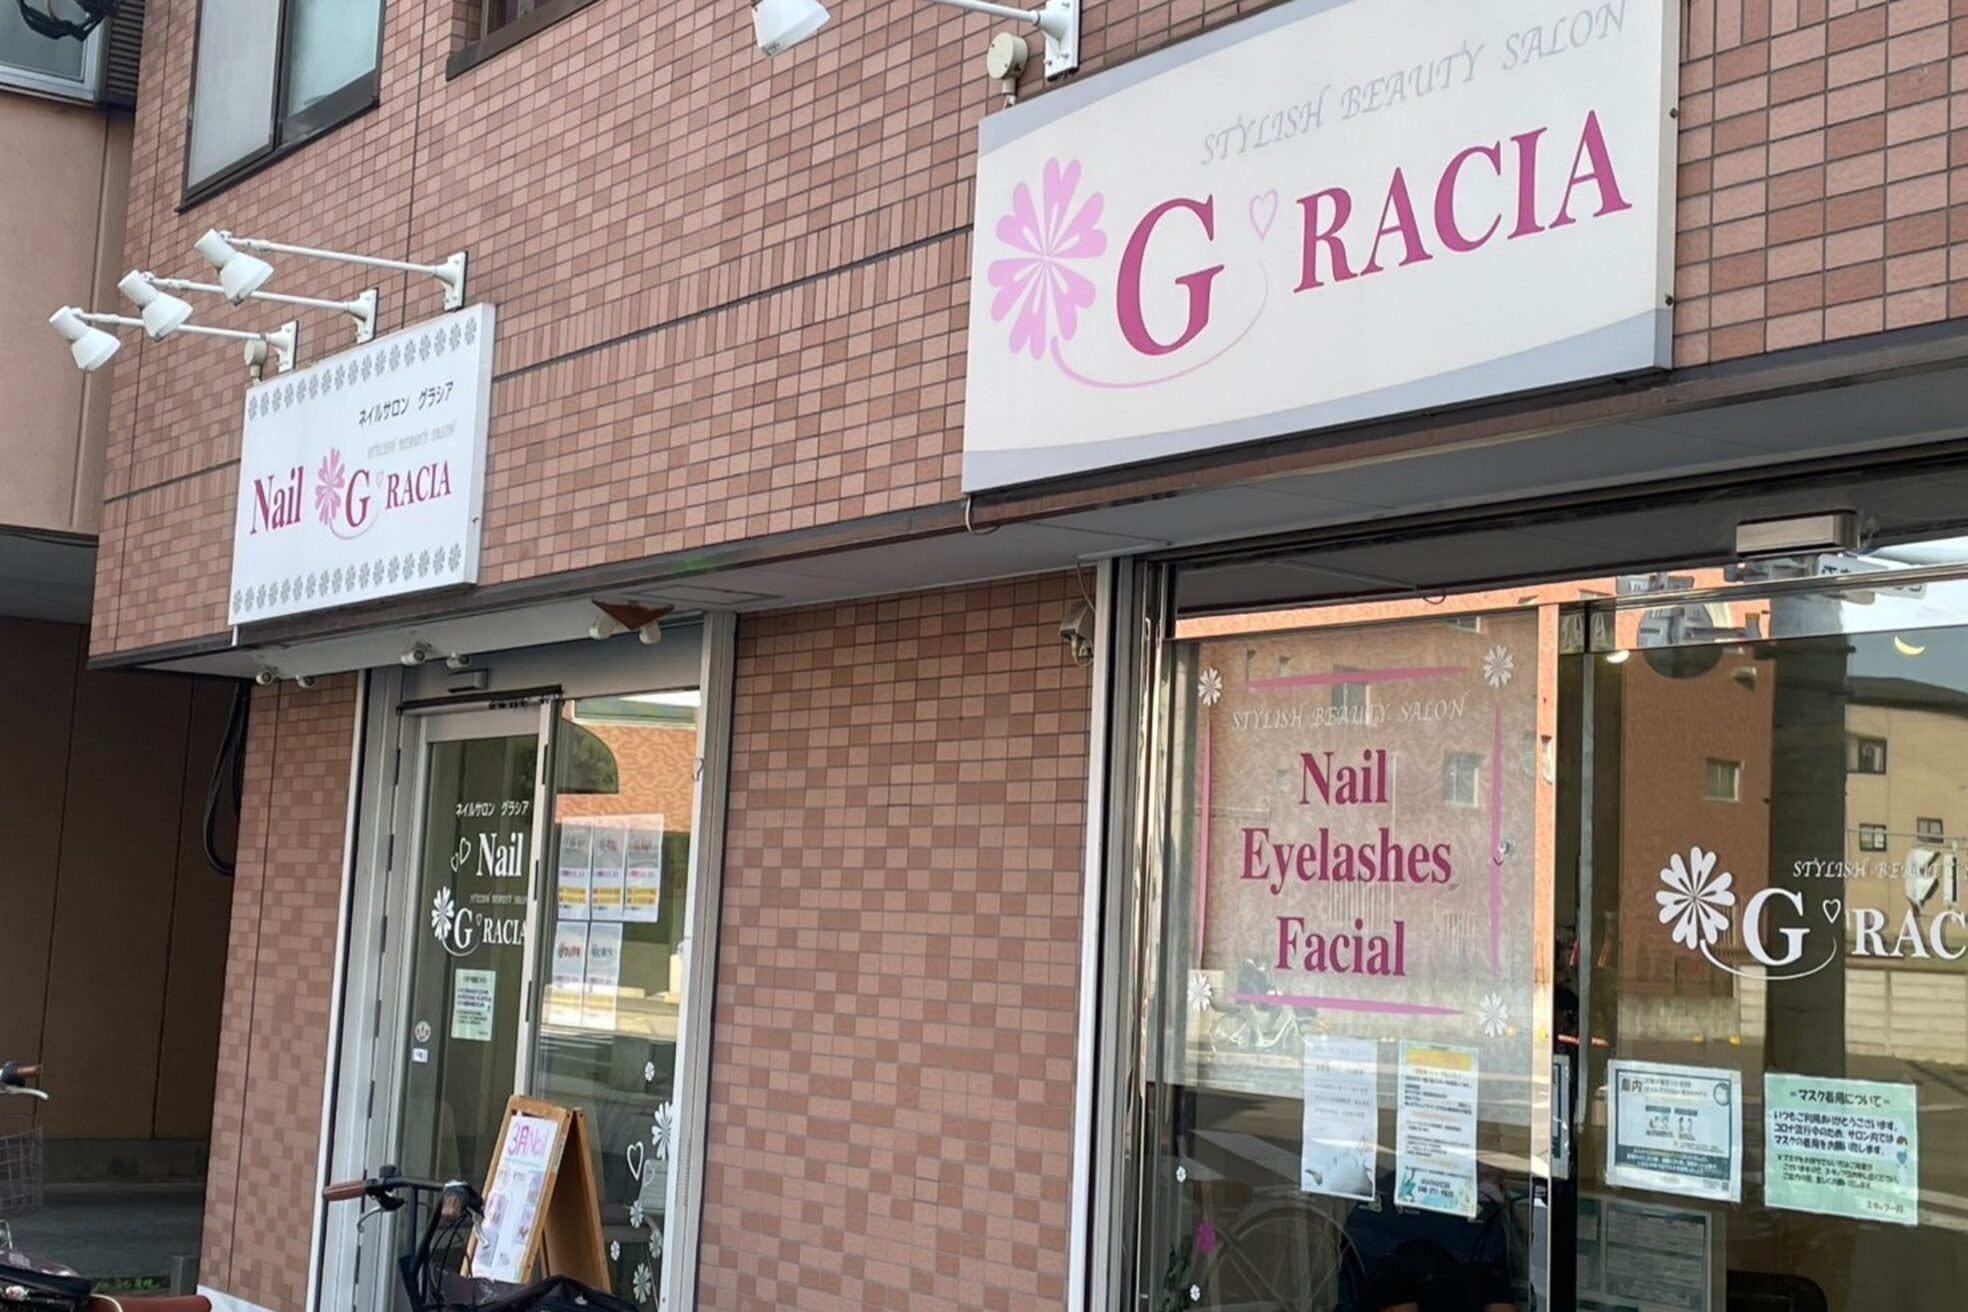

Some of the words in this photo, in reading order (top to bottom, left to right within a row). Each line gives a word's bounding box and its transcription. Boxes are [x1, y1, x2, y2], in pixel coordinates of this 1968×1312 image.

[1200, 84, 1331, 166] STYLISH
[1340, 40, 1485, 120] BEAUTY
[1502, 0, 1628, 71] SALON
[358, 398, 410, 427] ネイルサロン
[418, 381, 454, 410] グラシア
[250, 465, 304, 535] Nail
[1232, 701, 1310, 731] STYLISH
[1312, 702, 1390, 727] BEAUTY
[1399, 690, 1470, 723] SALON
[1299, 749, 1388, 805] Nail
[455, 802, 496, 818] ネイルサロン
[501, 800, 530, 817] グラシア
[476, 832, 524, 878] Nail
[1240, 827, 1452, 896] Eyelashes
[1792, 857, 1867, 878] STYLISH
[1275, 916, 1407, 977] Facial
